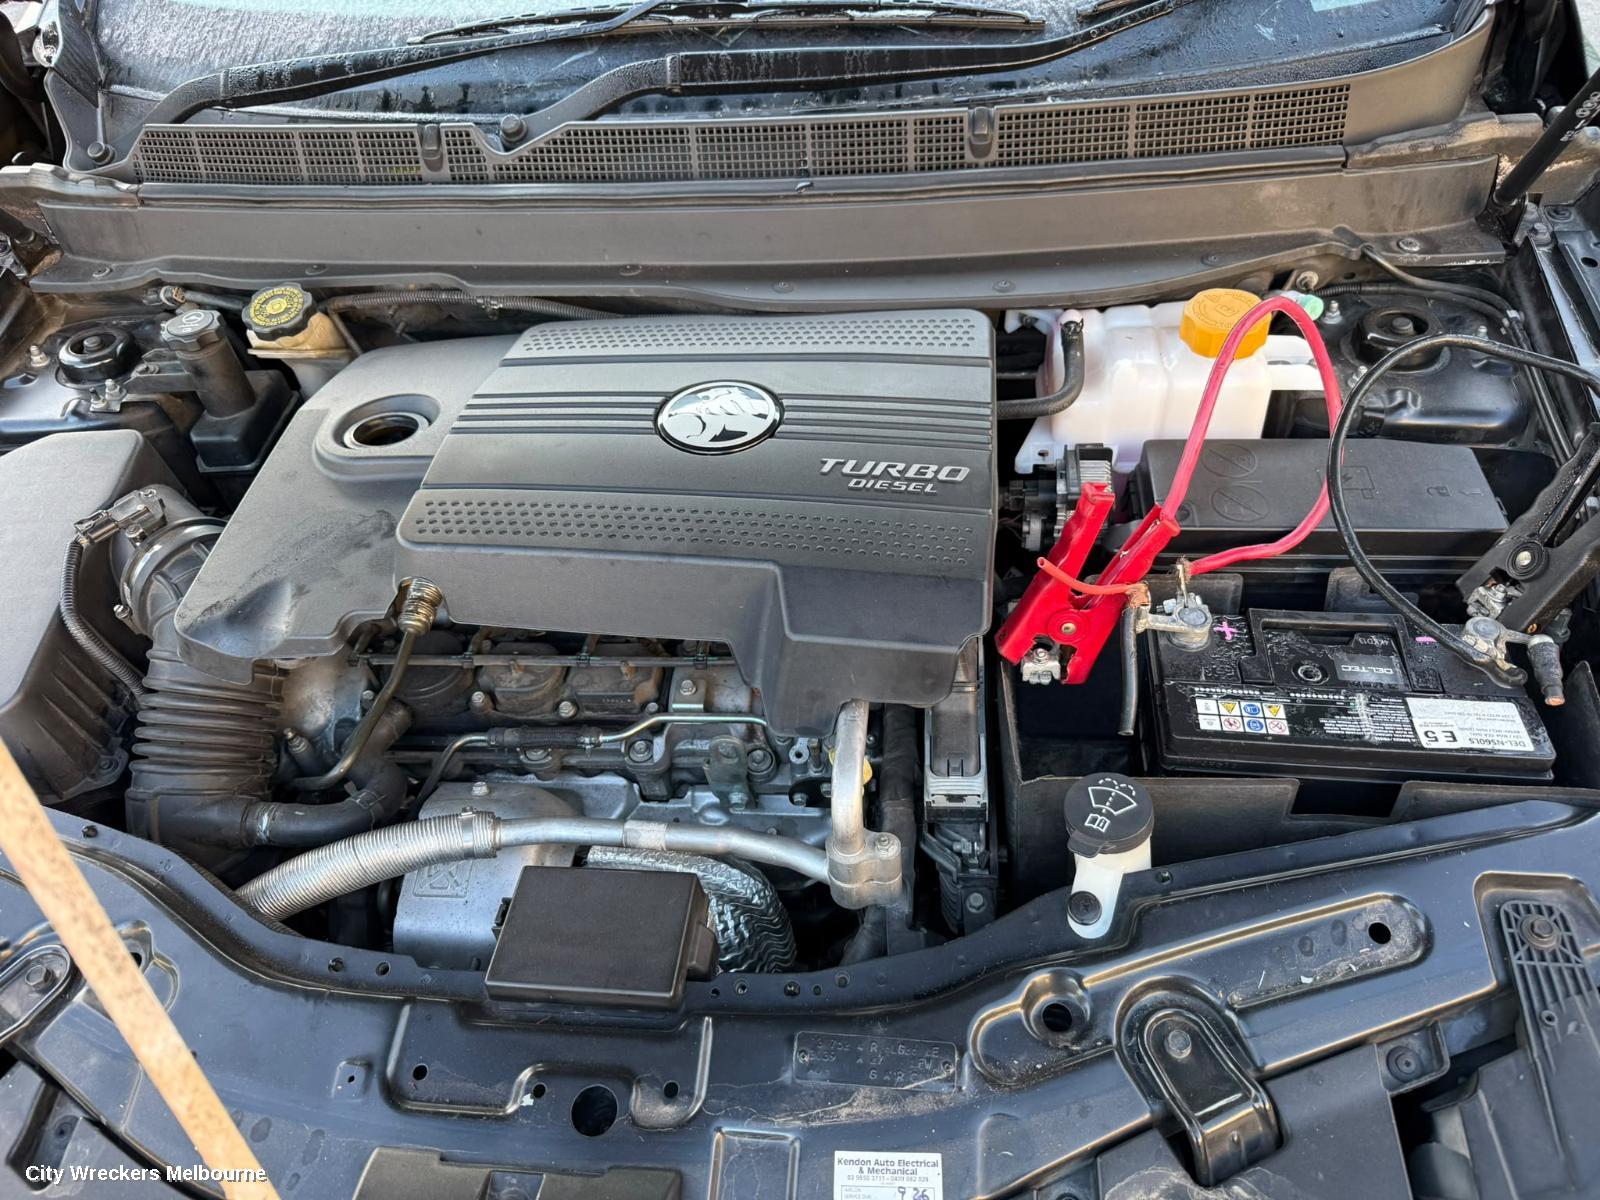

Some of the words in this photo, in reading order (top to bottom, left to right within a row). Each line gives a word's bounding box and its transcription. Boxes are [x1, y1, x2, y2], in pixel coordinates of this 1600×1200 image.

[820, 458, 970, 482] TURBO
[848, 479, 937, 495] DIESEL
[1341, 664, 1394, 675] DELTEC
[837, 1158, 872, 1167] Kendon
[873, 1159, 895, 1167] Auto
[897, 1159, 939, 1168] Electrical
[867, 1167, 918, 1176] Mechanical
